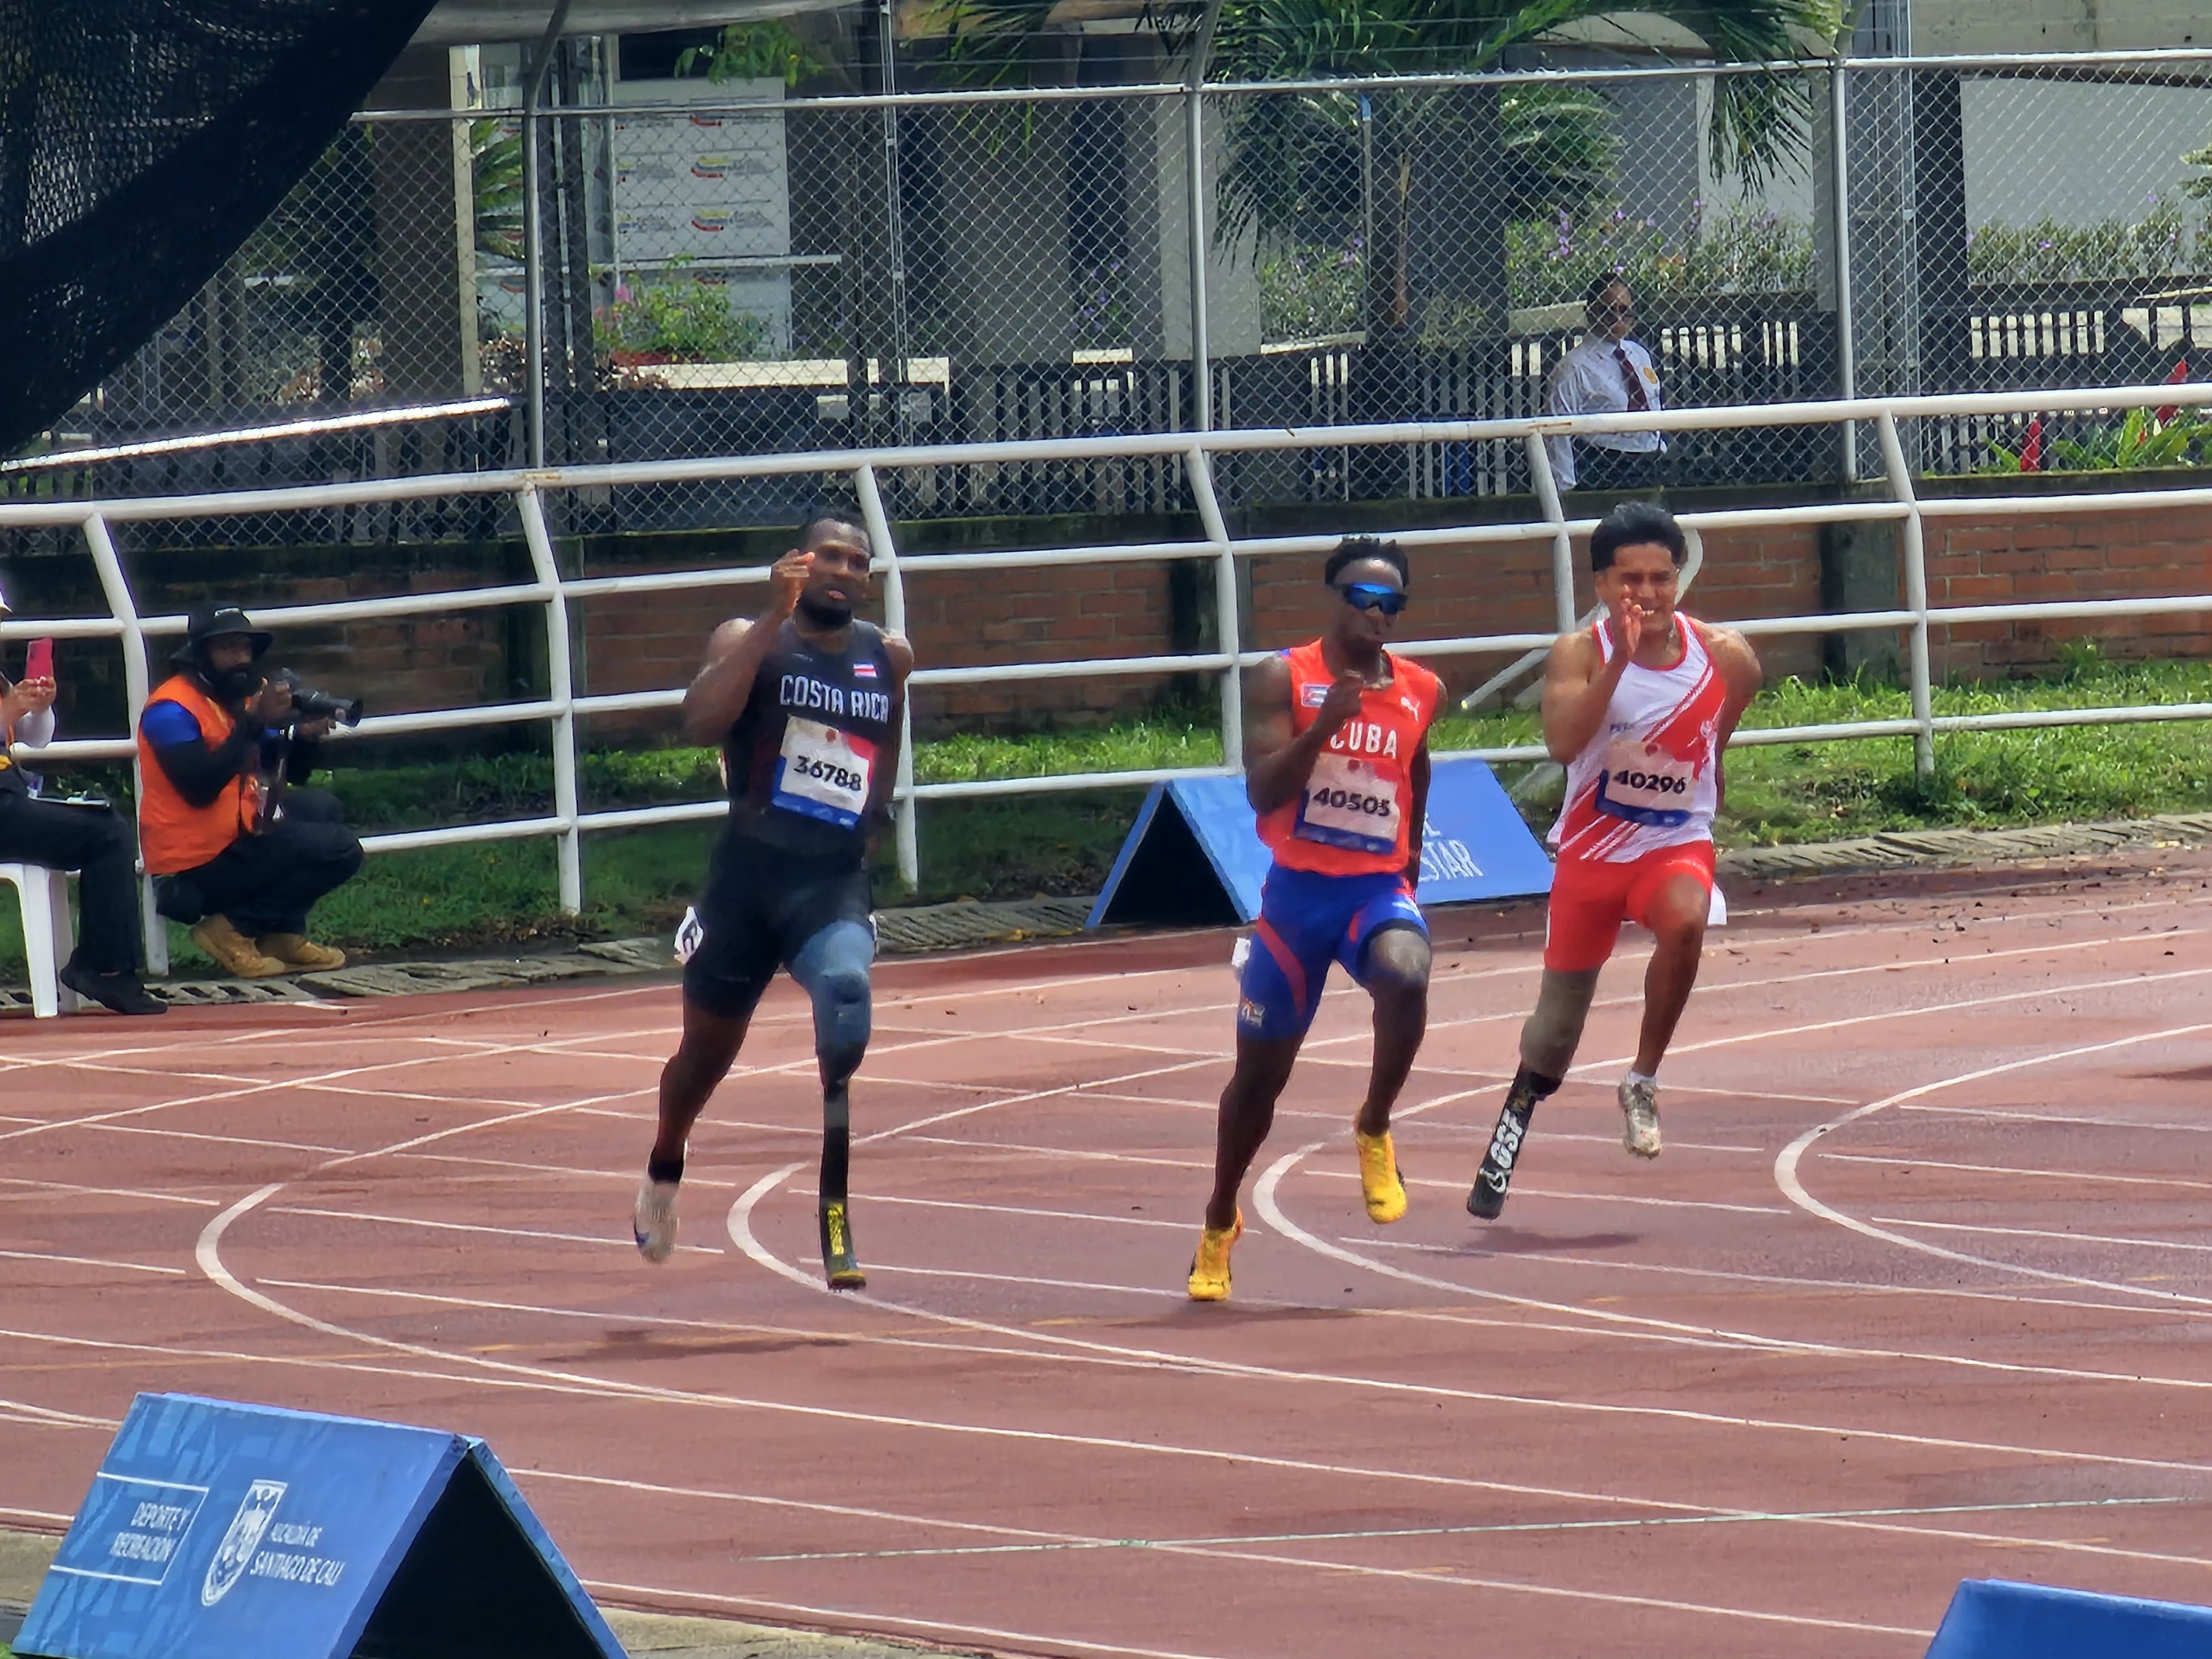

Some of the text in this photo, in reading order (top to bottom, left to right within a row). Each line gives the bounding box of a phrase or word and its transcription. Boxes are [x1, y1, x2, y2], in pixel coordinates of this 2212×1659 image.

[780, 675, 889, 723] COSTA RICA
[1331, 719, 1397, 759] CUBA
[794, 755, 862, 791] 36788
[1613, 769, 1686, 794] 40296
[1312, 787, 1390, 817] 40505
[1417, 839, 1484, 883] STAR
